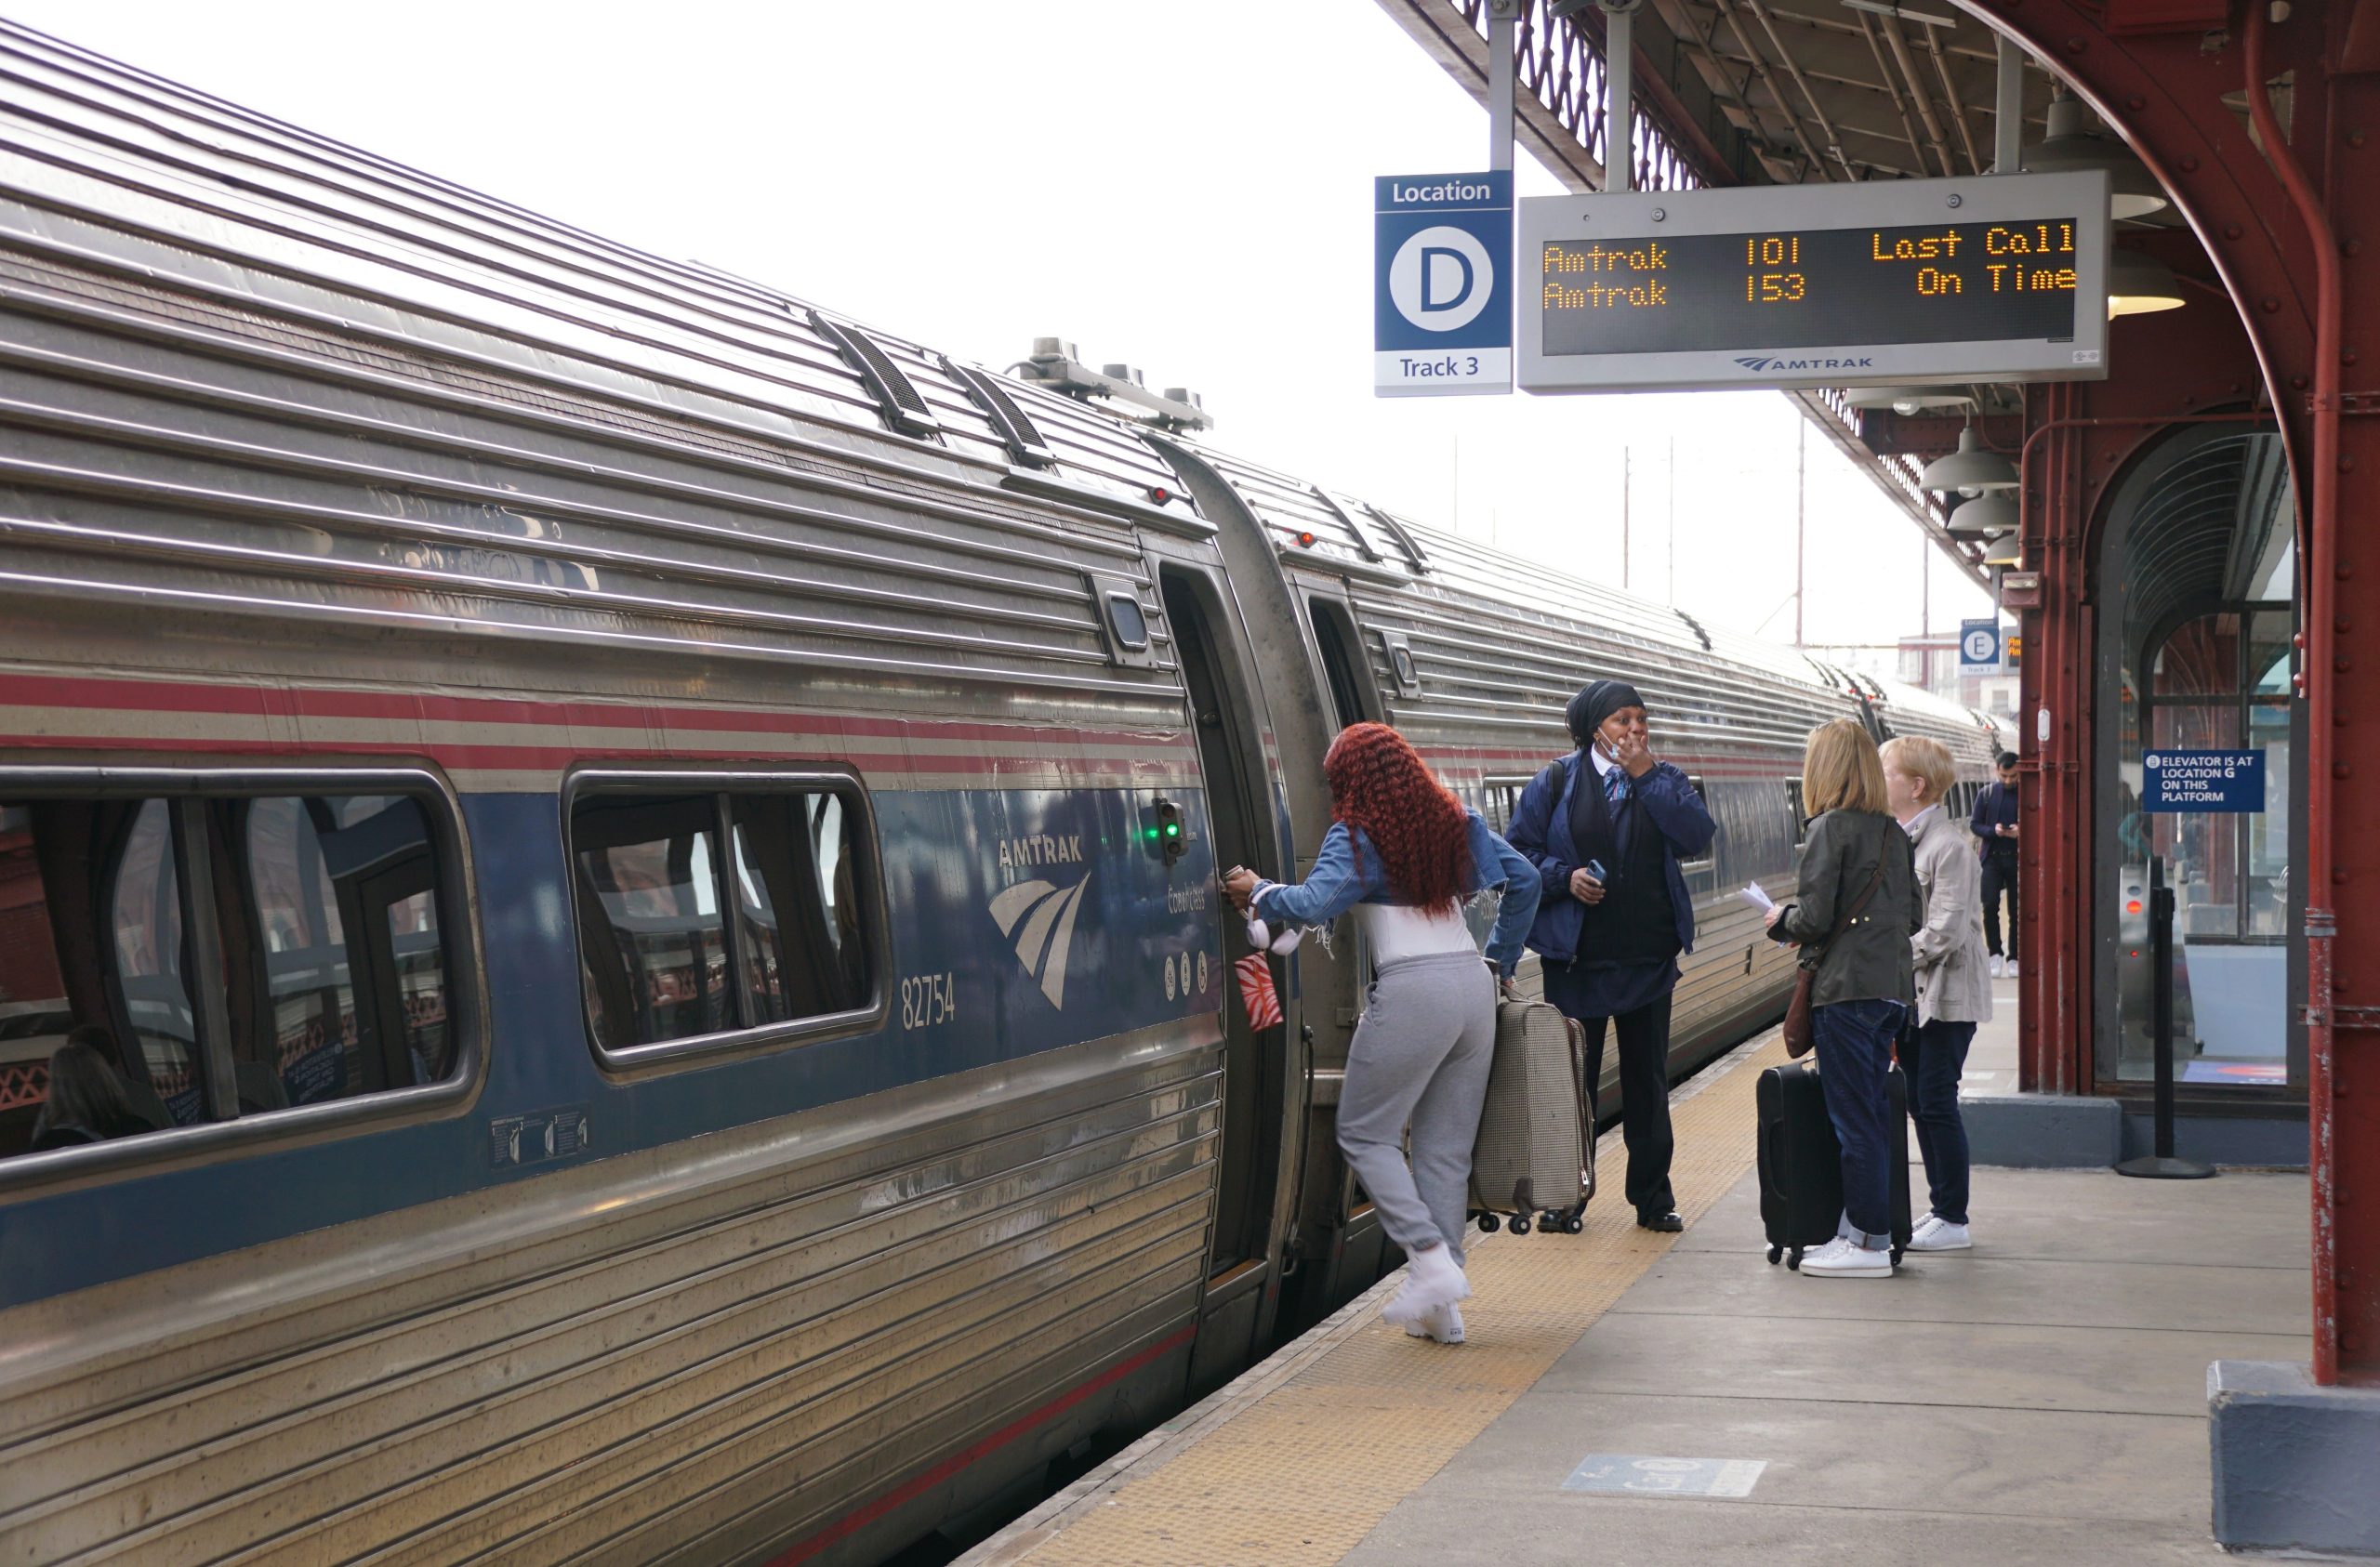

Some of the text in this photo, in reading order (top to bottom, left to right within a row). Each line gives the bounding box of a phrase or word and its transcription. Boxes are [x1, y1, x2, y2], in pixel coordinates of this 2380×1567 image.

[1394, 181, 1490, 203] Location
[1544, 224, 2074, 273] Amtrak 101 Last Call
[1421, 246, 1474, 313] D
[1544, 264, 2077, 309] Amtrak 153 On Time
[1400, 356, 1480, 377] Track 3
[1771, 358, 1873, 370] AMTRAK
[1974, 636, 1986, 655] E
[2162, 757, 2254, 767] ELEVATOR IS AT
[2162, 767, 2235, 779] LOCATION G
[2162, 780, 2209, 790] ON THIS
[2162, 792, 2224, 802] PLATFORM
[999, 835, 1083, 869] AMTRAK
[902, 971, 955, 1031] 82754
